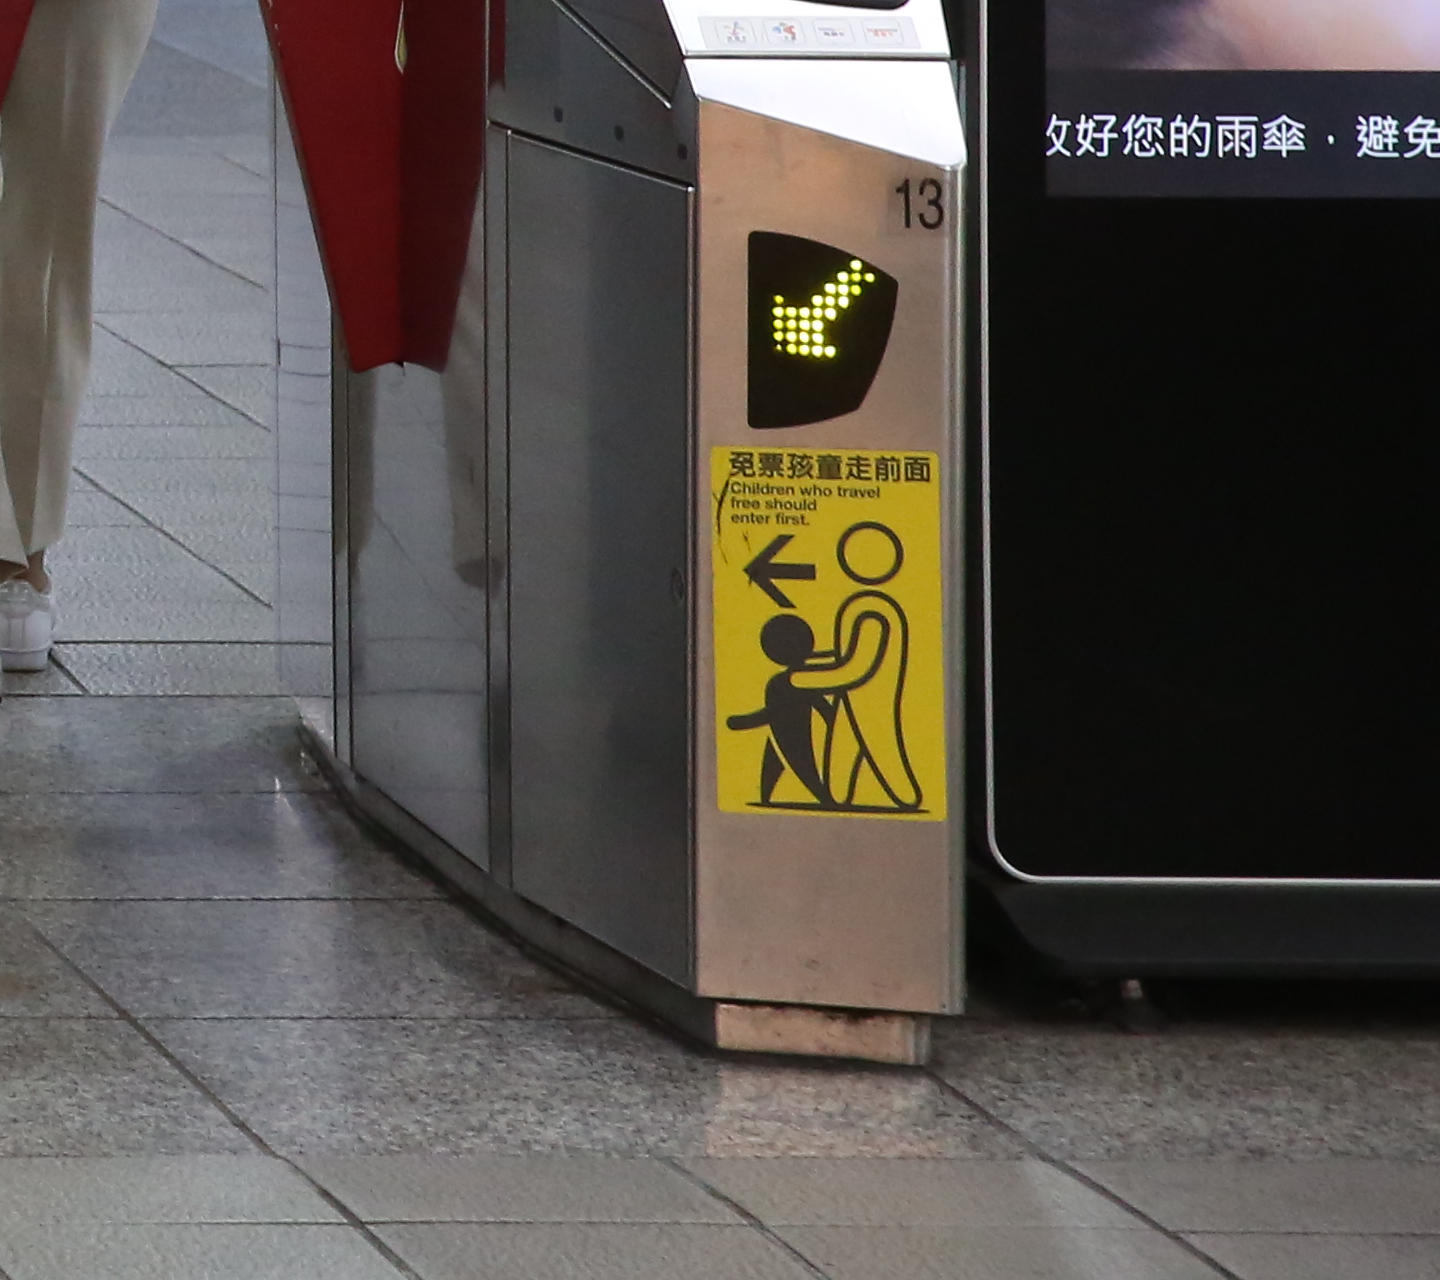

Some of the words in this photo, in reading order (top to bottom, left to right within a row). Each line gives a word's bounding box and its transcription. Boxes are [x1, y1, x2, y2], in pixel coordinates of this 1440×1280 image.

[895, 178, 945, 230] 13
[731, 481, 795, 496] Children
[800, 484, 832, 497] who
[837, 486, 881, 499] travel
[731, 497, 760, 509] free
[764, 498, 817, 511] should
[731, 513, 770, 525] enter
[776, 513, 810, 526] first.
